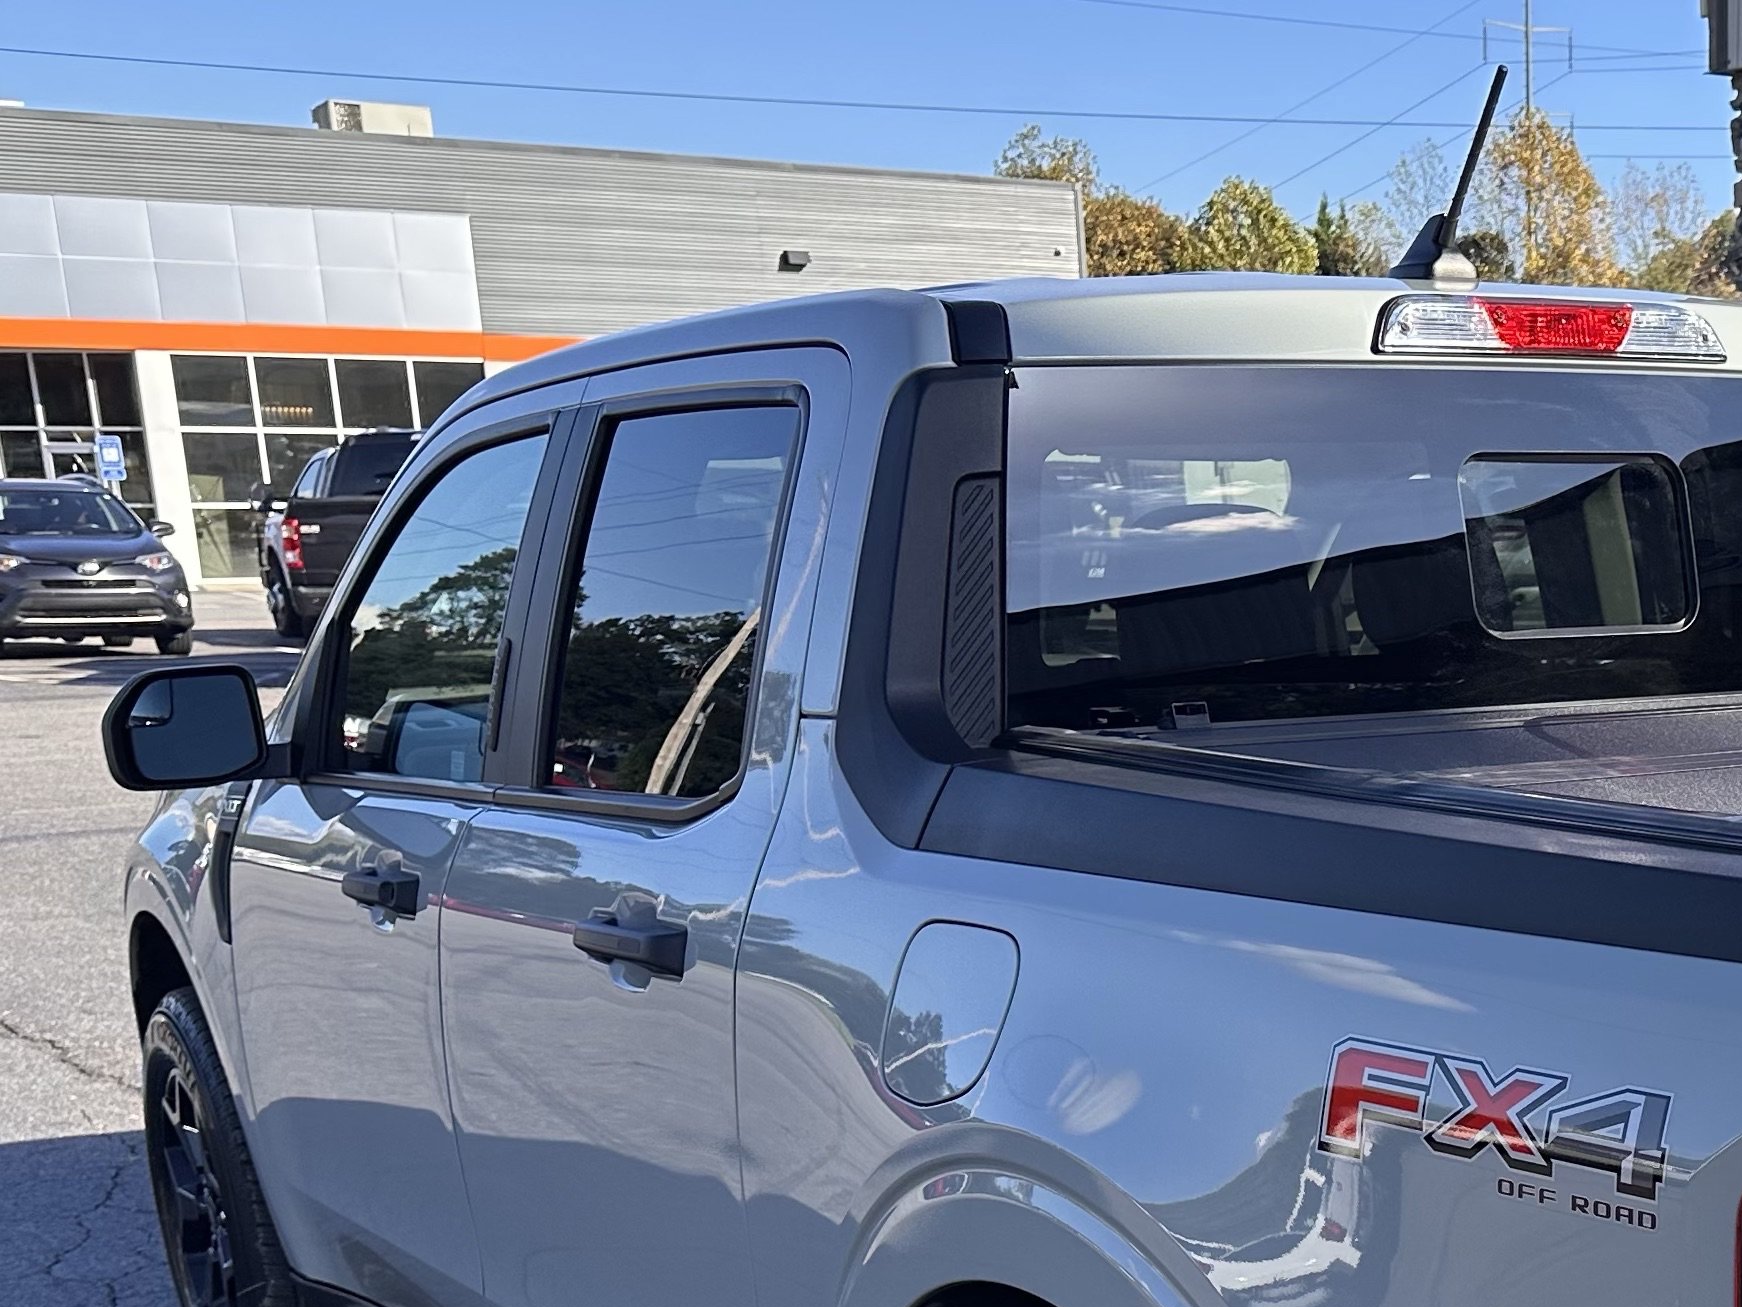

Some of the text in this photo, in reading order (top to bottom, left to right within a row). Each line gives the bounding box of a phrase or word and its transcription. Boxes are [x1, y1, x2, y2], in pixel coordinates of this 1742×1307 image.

[1317, 1033, 1674, 1201] FX4
[1496, 1177, 1657, 1231] OFF ROAD
